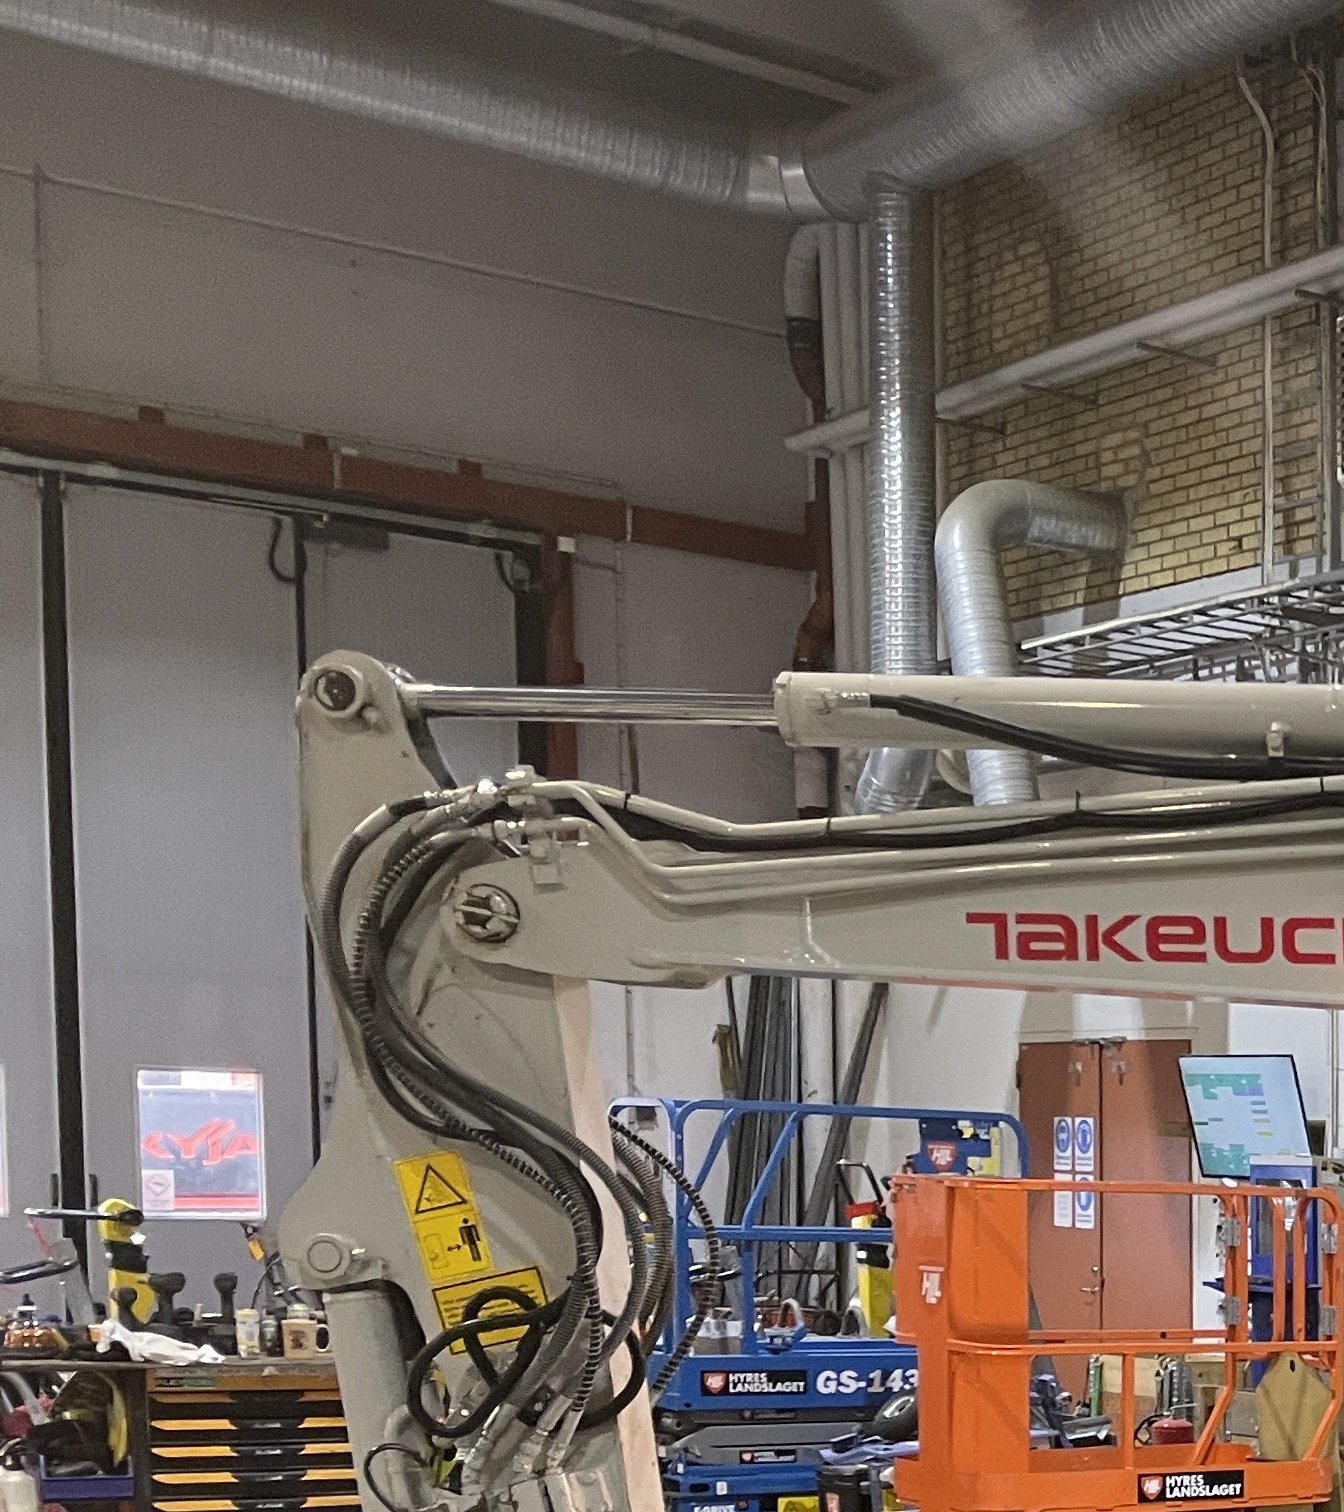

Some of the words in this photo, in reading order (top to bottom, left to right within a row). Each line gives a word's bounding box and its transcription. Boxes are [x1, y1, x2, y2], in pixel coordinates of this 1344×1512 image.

[728, 1380, 806, 1393] LANDSLAGET
[1165, 1474, 1204, 1488] HYRES
[1165, 1483, 1242, 1498] LANDSLAGET
